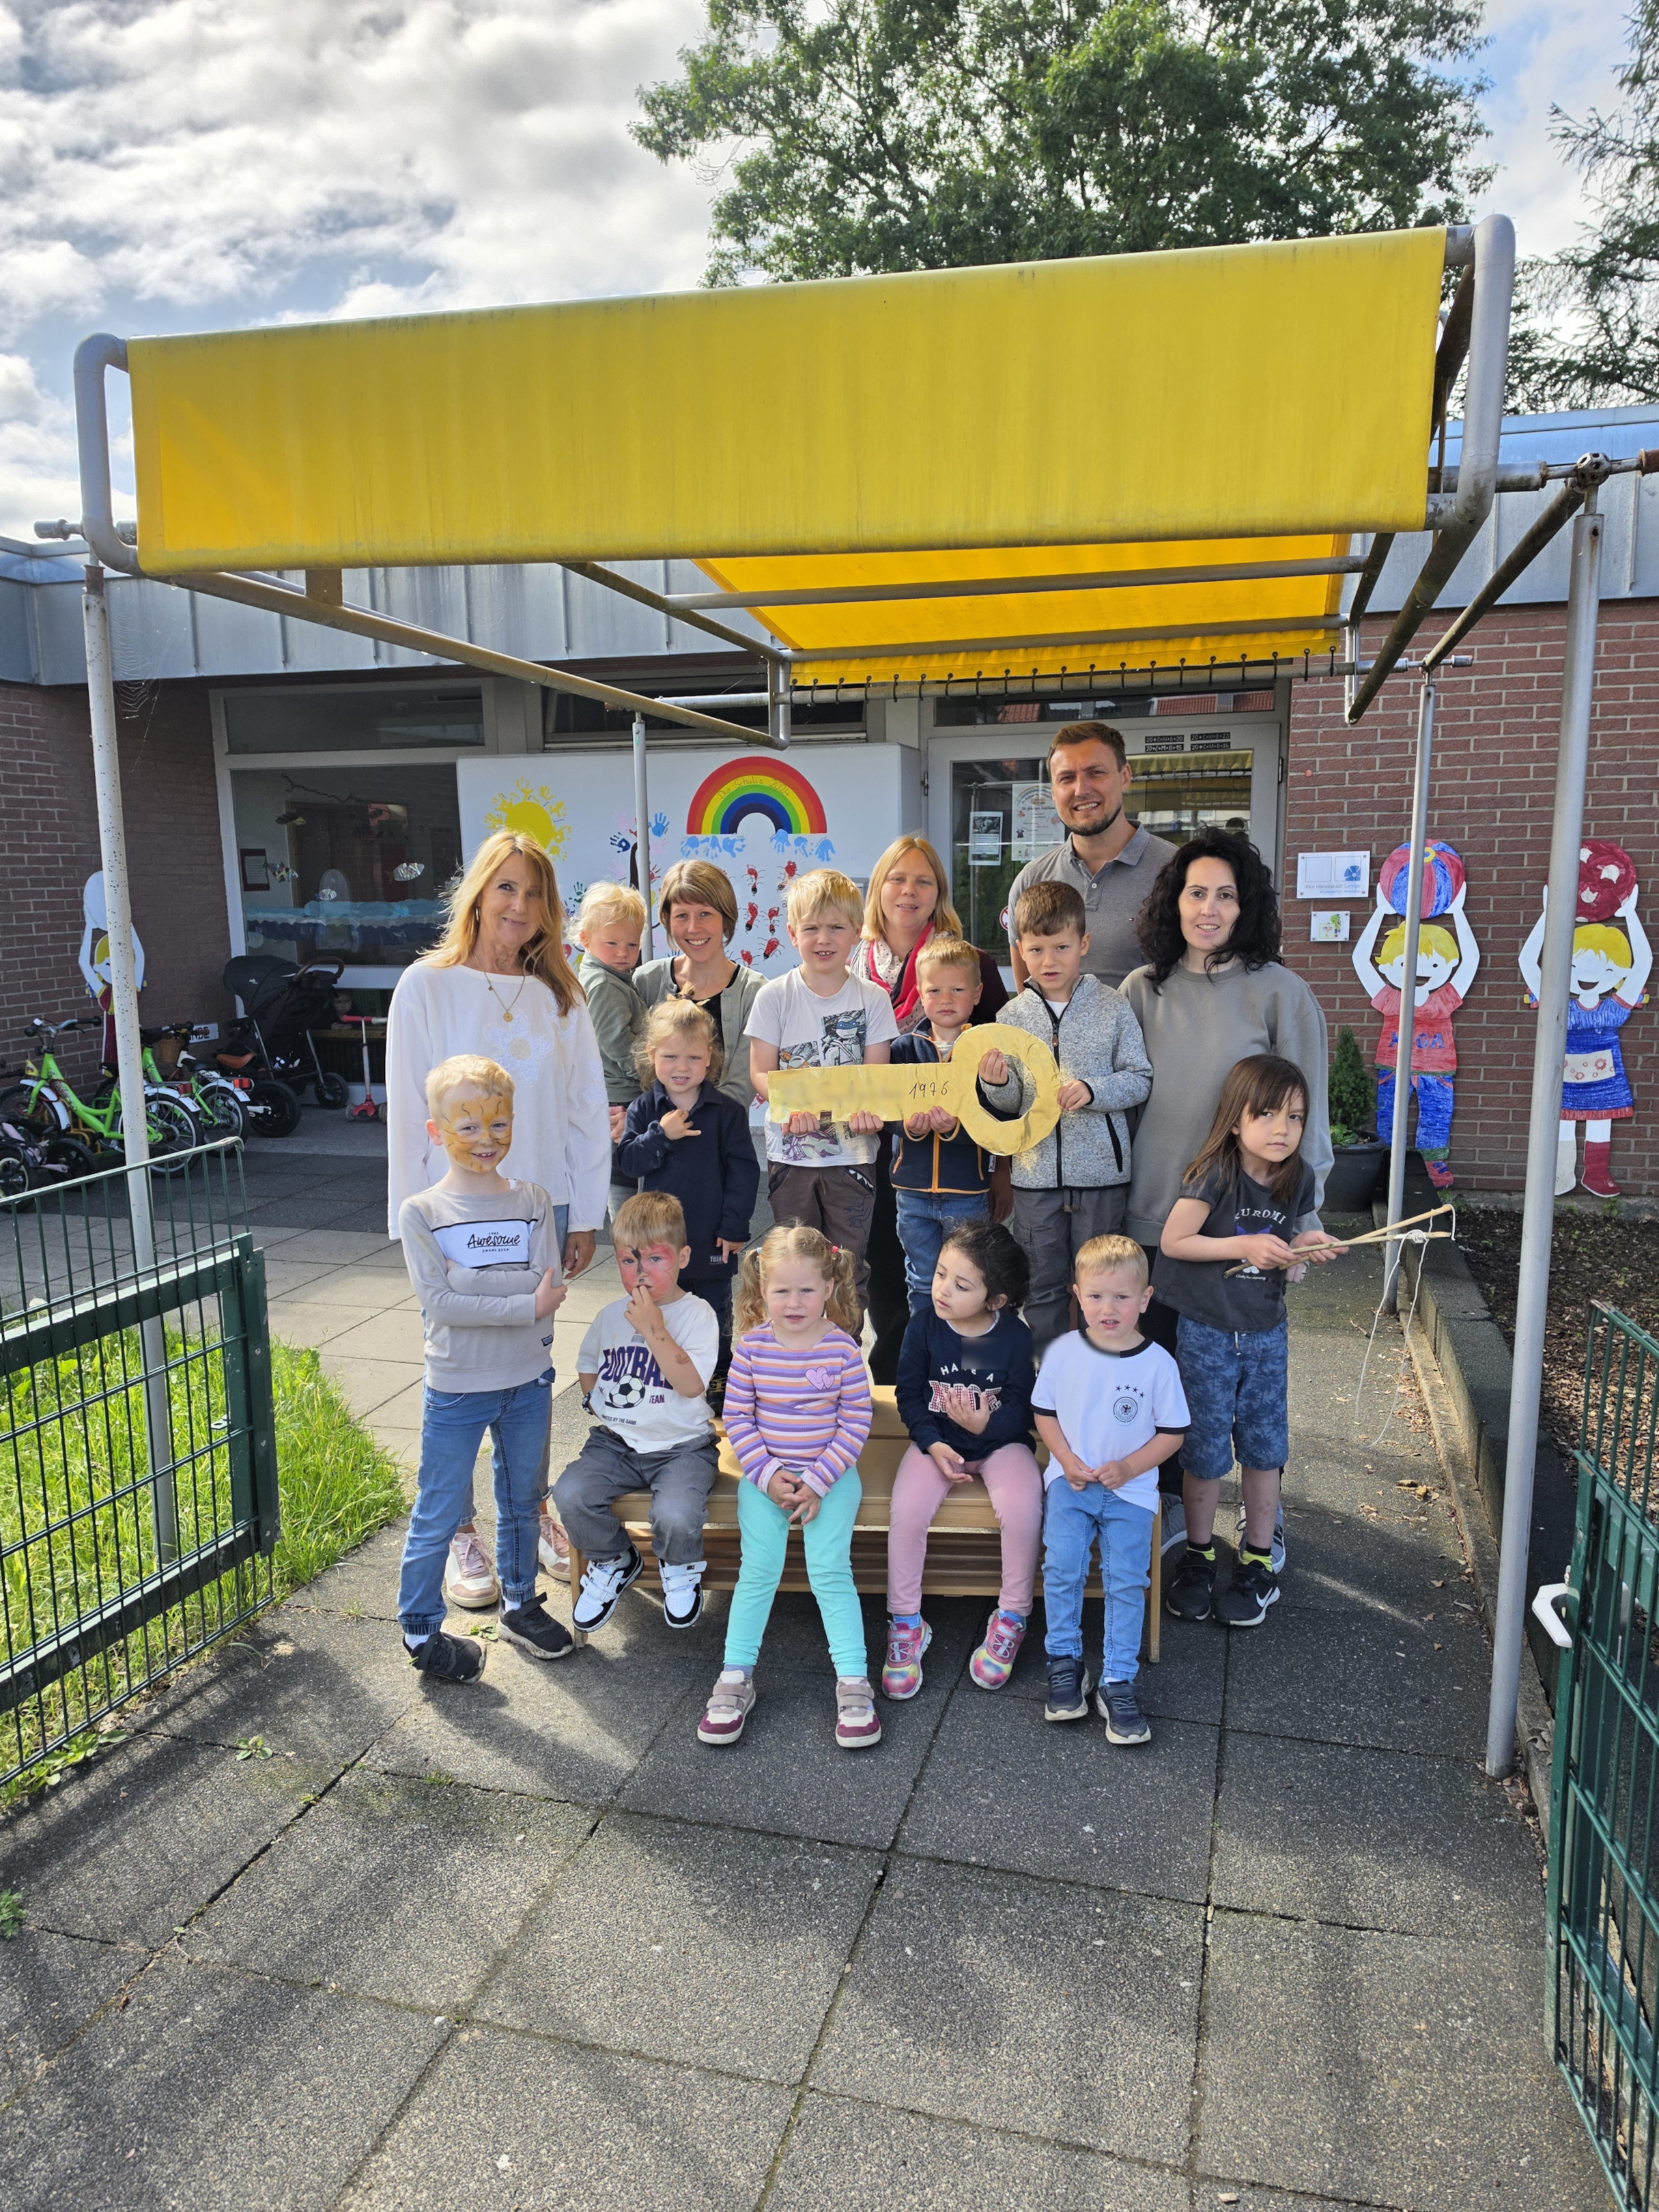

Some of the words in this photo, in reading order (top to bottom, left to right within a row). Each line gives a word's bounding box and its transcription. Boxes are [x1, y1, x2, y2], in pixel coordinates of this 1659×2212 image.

[769, 779, 790, 797] 2024
[909, 1081, 949, 1099] 1976
[466, 1234, 521, 1249] Awesome
[597, 1346, 674, 1391] FOOTBA
[986, 1373, 994, 1382] A
